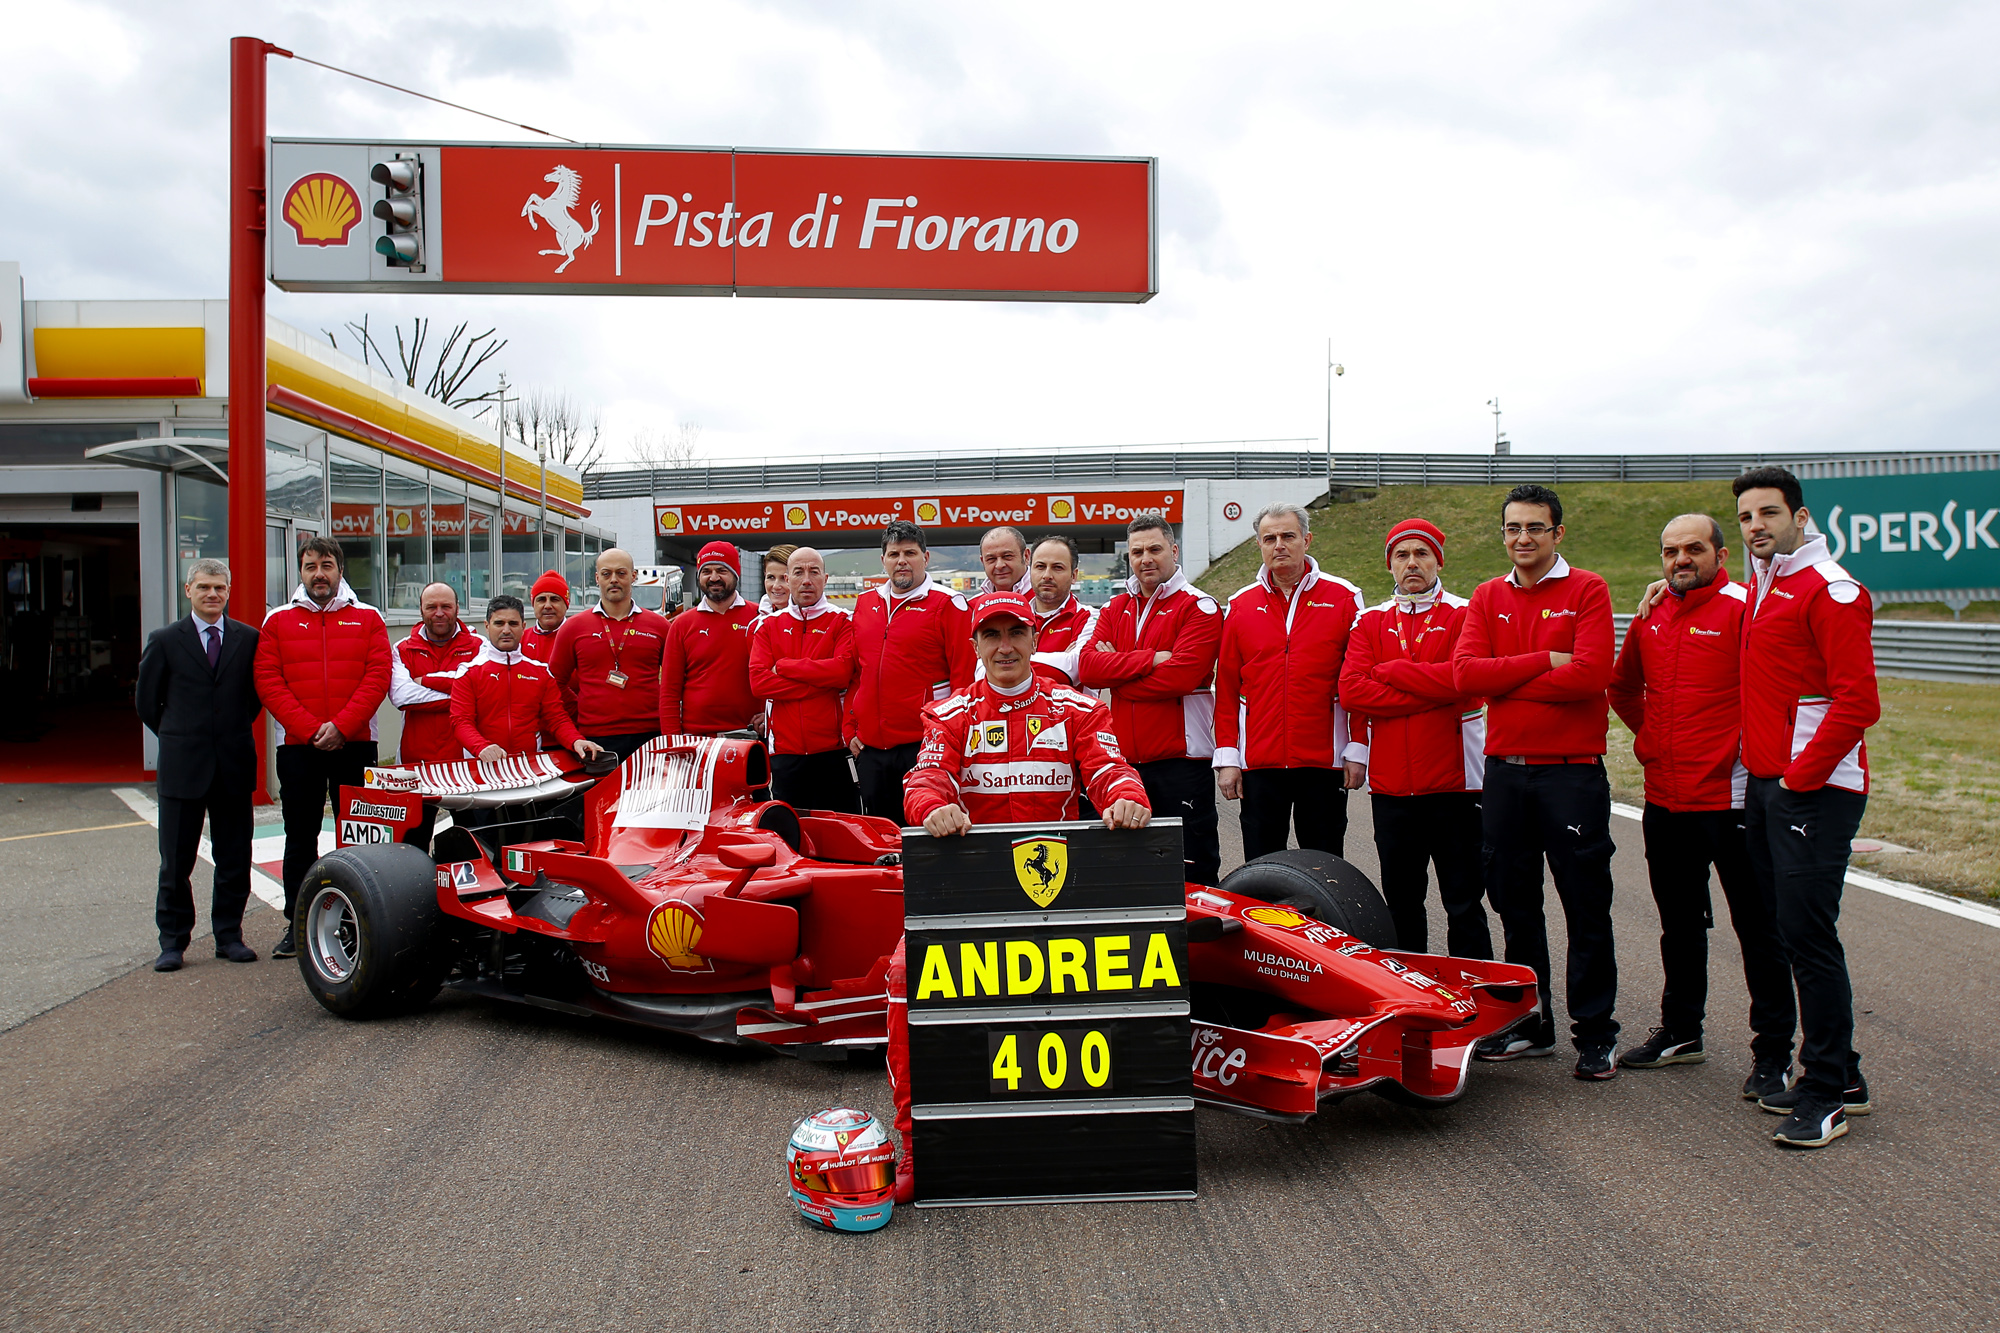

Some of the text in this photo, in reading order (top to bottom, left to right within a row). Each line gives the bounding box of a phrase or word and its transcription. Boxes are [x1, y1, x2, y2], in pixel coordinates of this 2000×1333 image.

[633, 192, 1080, 254] Pista di Fiorano
[814, 509, 900, 527] V-Power
[945, 506, 1033, 523] V-Power
[1080, 503, 1170, 520] V-Power
[687, 514, 770, 531] V-Power
[984, 597, 1024, 607] Santander
[987, 731, 1005, 745] ups
[982, 768, 1072, 788] Santander
[351, 800, 406, 820] BRIDGESTONE
[342, 822, 381, 844] AMD
[438, 871, 450, 888] FIAT
[1303, 925, 1349, 944] Alice
[915, 932, 1182, 1000] ANDREA
[1244, 949, 1324, 975] MUBADALA
[1257, 966, 1310, 983] ABU DHABI
[1319, 1020, 1365, 1051] V-Power
[992, 1029, 1112, 1091] 400
[829, 1159, 856, 1169] HUBLOT
